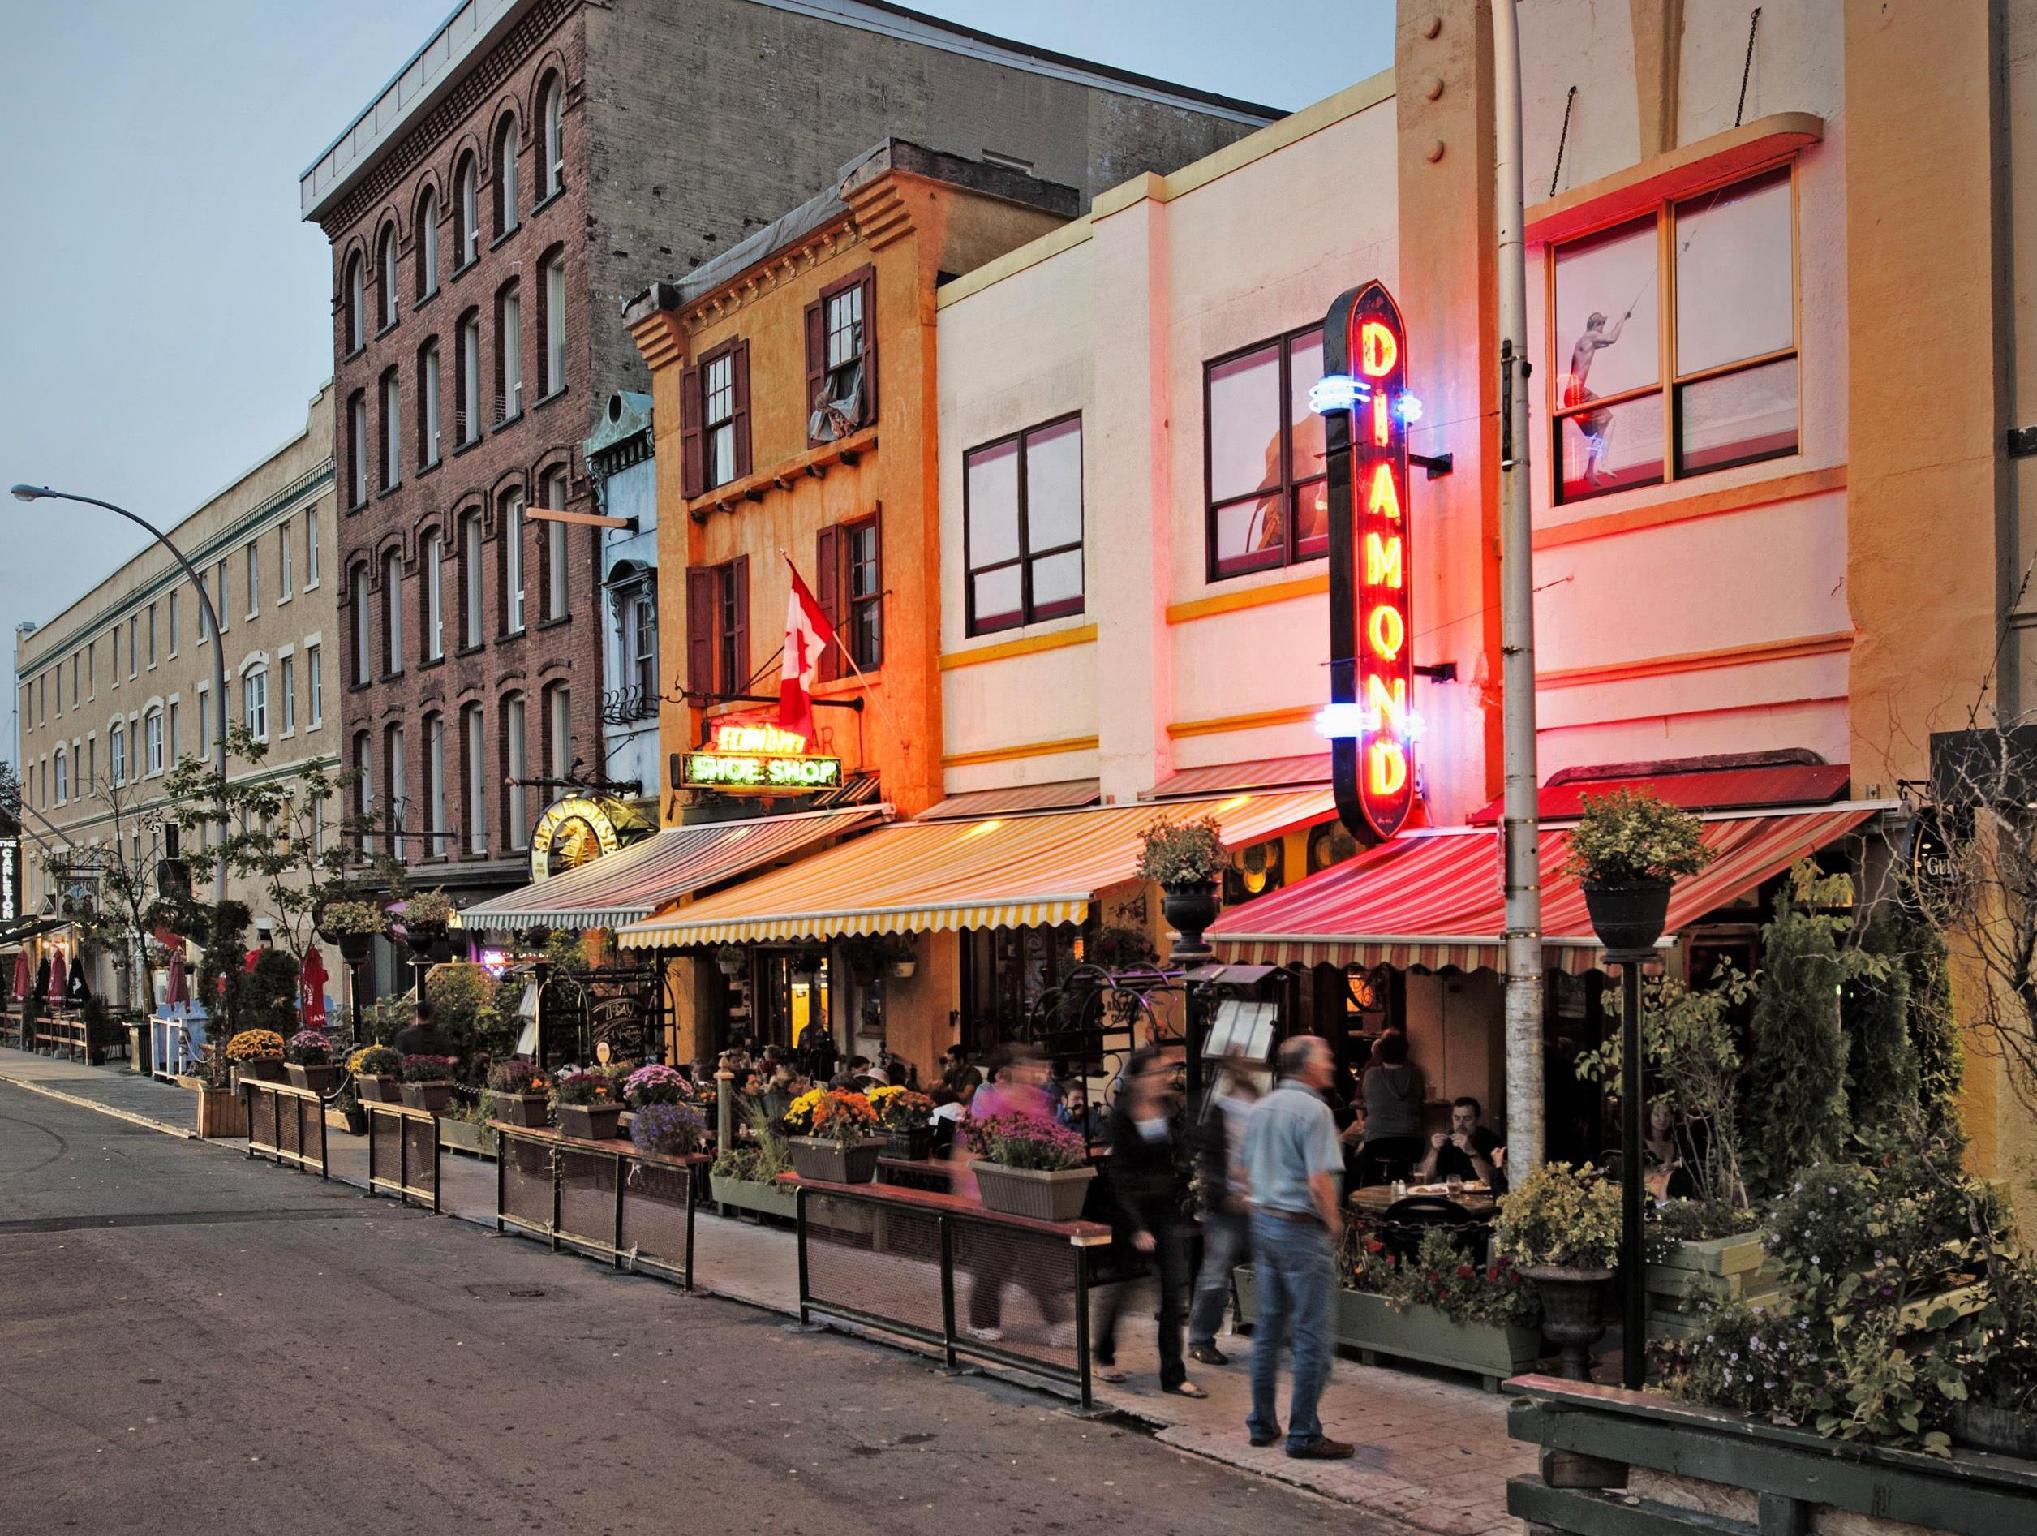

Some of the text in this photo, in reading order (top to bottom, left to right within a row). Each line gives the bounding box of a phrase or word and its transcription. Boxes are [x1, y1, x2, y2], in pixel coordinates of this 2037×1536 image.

[1361, 322, 1406, 796] DIAMOND
[692, 755, 837, 783] SHOE SHOP
